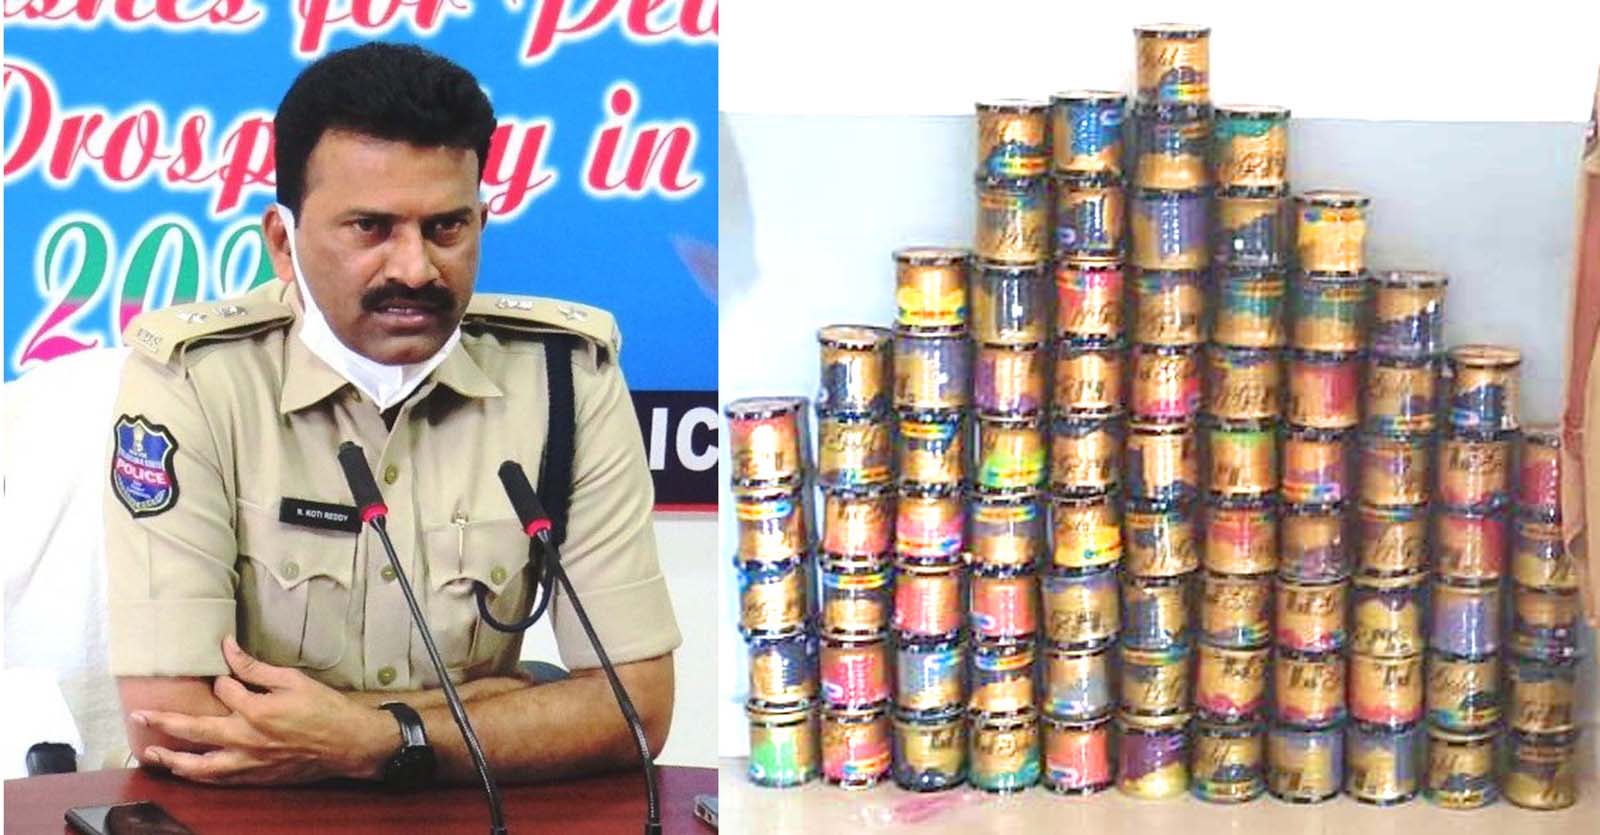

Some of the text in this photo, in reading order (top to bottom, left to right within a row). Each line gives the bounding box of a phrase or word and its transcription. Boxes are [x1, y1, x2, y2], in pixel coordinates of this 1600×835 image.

[588, 88, 697, 191] in
[116, 457, 167, 486] POLICE
[305, 509, 322, 519] KOTI
[324, 511, 348, 521] REDDY
